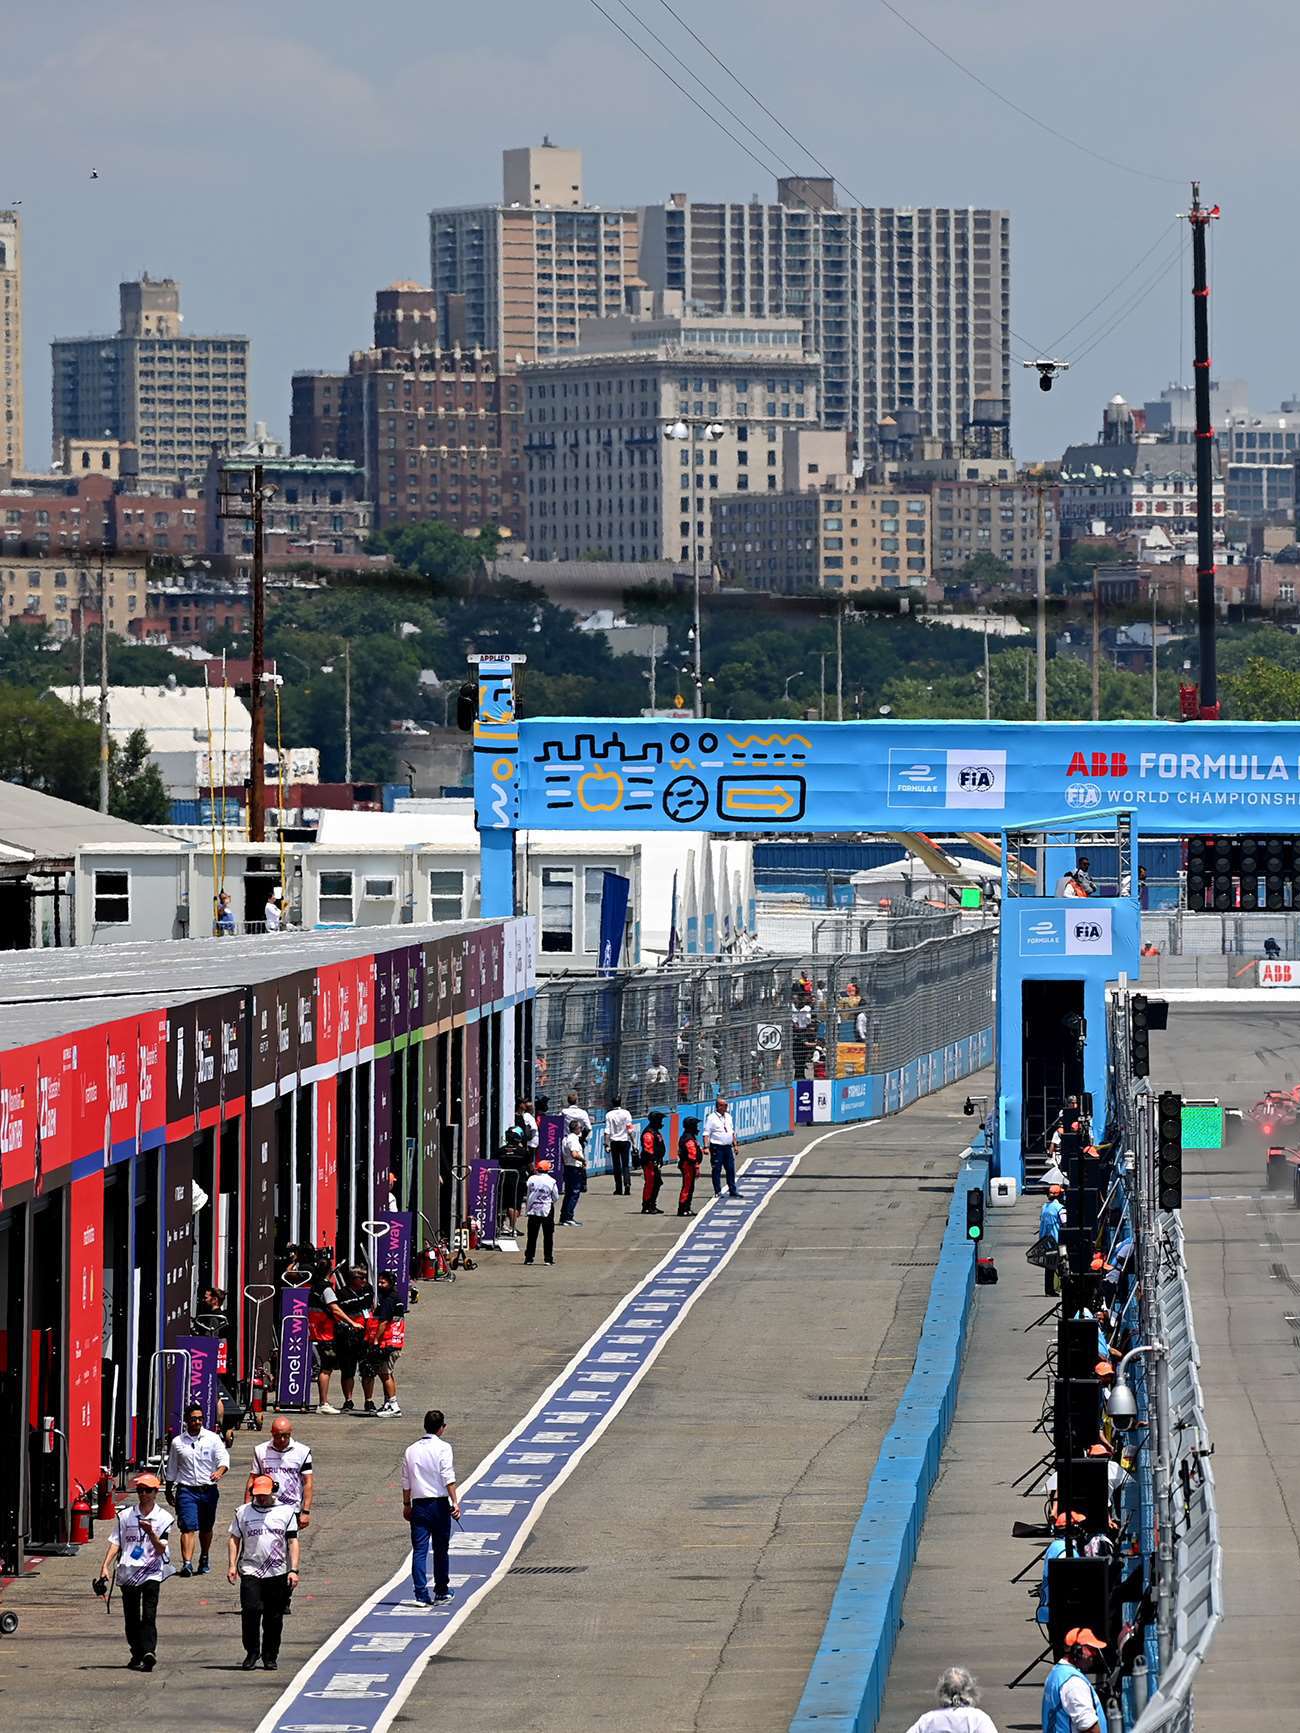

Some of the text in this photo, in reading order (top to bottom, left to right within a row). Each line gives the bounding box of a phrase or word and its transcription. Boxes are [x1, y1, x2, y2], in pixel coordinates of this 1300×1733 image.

[1068, 752, 1128, 777] ABB
[1140, 753, 1289, 780] FORMULA
[897, 784, 931, 792] FORMULA
[1107, 791, 1169, 805] WORLD
[1263, 964, 1293, 982] ABB
[761, 1030, 776, 1044] 50
[389, 1221, 404, 1250] way
[287, 1299, 306, 1395] way enel
[191, 1348, 208, 1386] way
